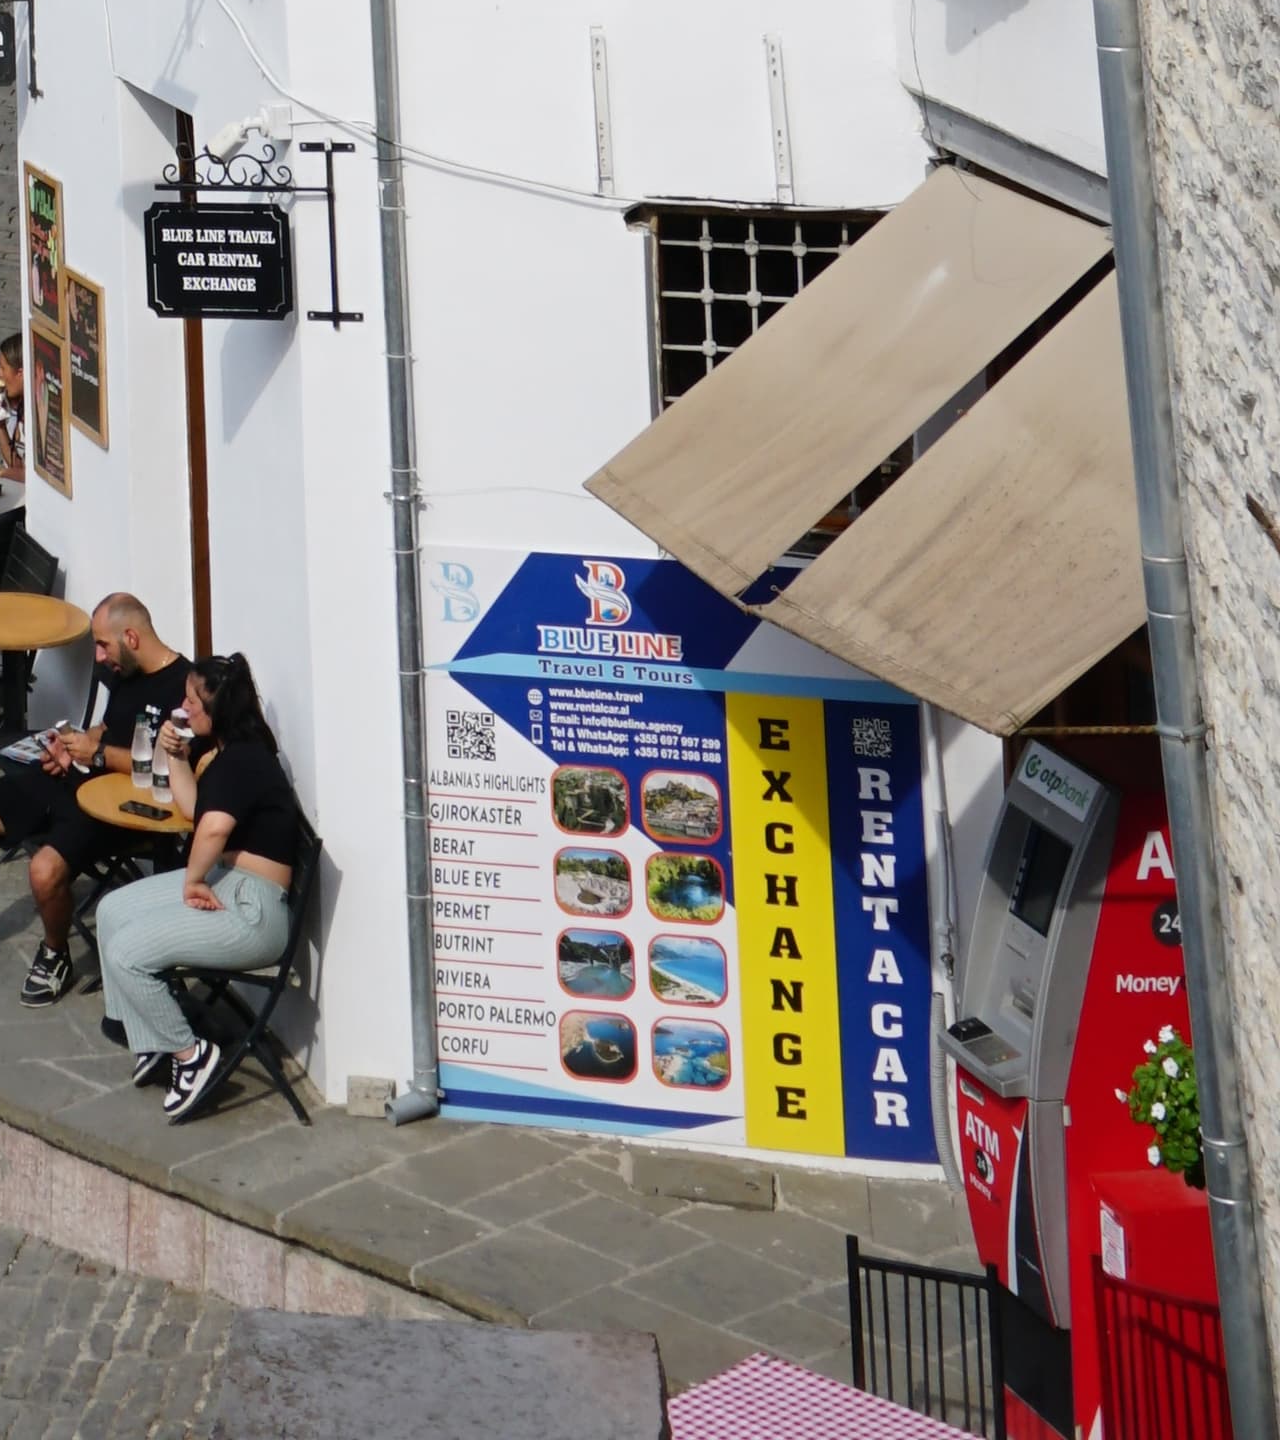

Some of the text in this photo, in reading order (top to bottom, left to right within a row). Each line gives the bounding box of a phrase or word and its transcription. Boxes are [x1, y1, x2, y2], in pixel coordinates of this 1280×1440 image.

[162, 229, 276, 244] BLUE LINE TRAVEL
[178, 252, 261, 268] CAR RENTAL
[183, 277, 256, 292] EXCHANGE
[539, 627, 683, 660] BLUE LINE
[539, 659, 693, 685] Travel & Tours
[549, 688, 643, 703] www.blueline.travel
[549, 701, 630, 715] www.rentalcar.al
[550, 713, 580, 726] Email:
[551, 727, 565, 737] Tel
[552, 740, 566, 751] Tel
[430, 771, 546, 794] ALBANIA'S HIGHLIGHTS
[430, 802, 523, 825] GJIROKASTËR
[433, 838, 475, 857] BERAT
[434, 868, 501, 889] BLUE EYE
[758, 717, 807, 1120] EXCHANGE
[435, 933, 494, 953] BUTRINT
[857, 767, 910, 1127] RENT A CAR
[436, 969, 491, 990] RIVIERA
[1116, 974, 1181, 996] Money
[439, 1001, 556, 1027] PORTO PALERMO
[441, 1036, 489, 1055] CORFU
[965, 1110, 1001, 1162] ATM
